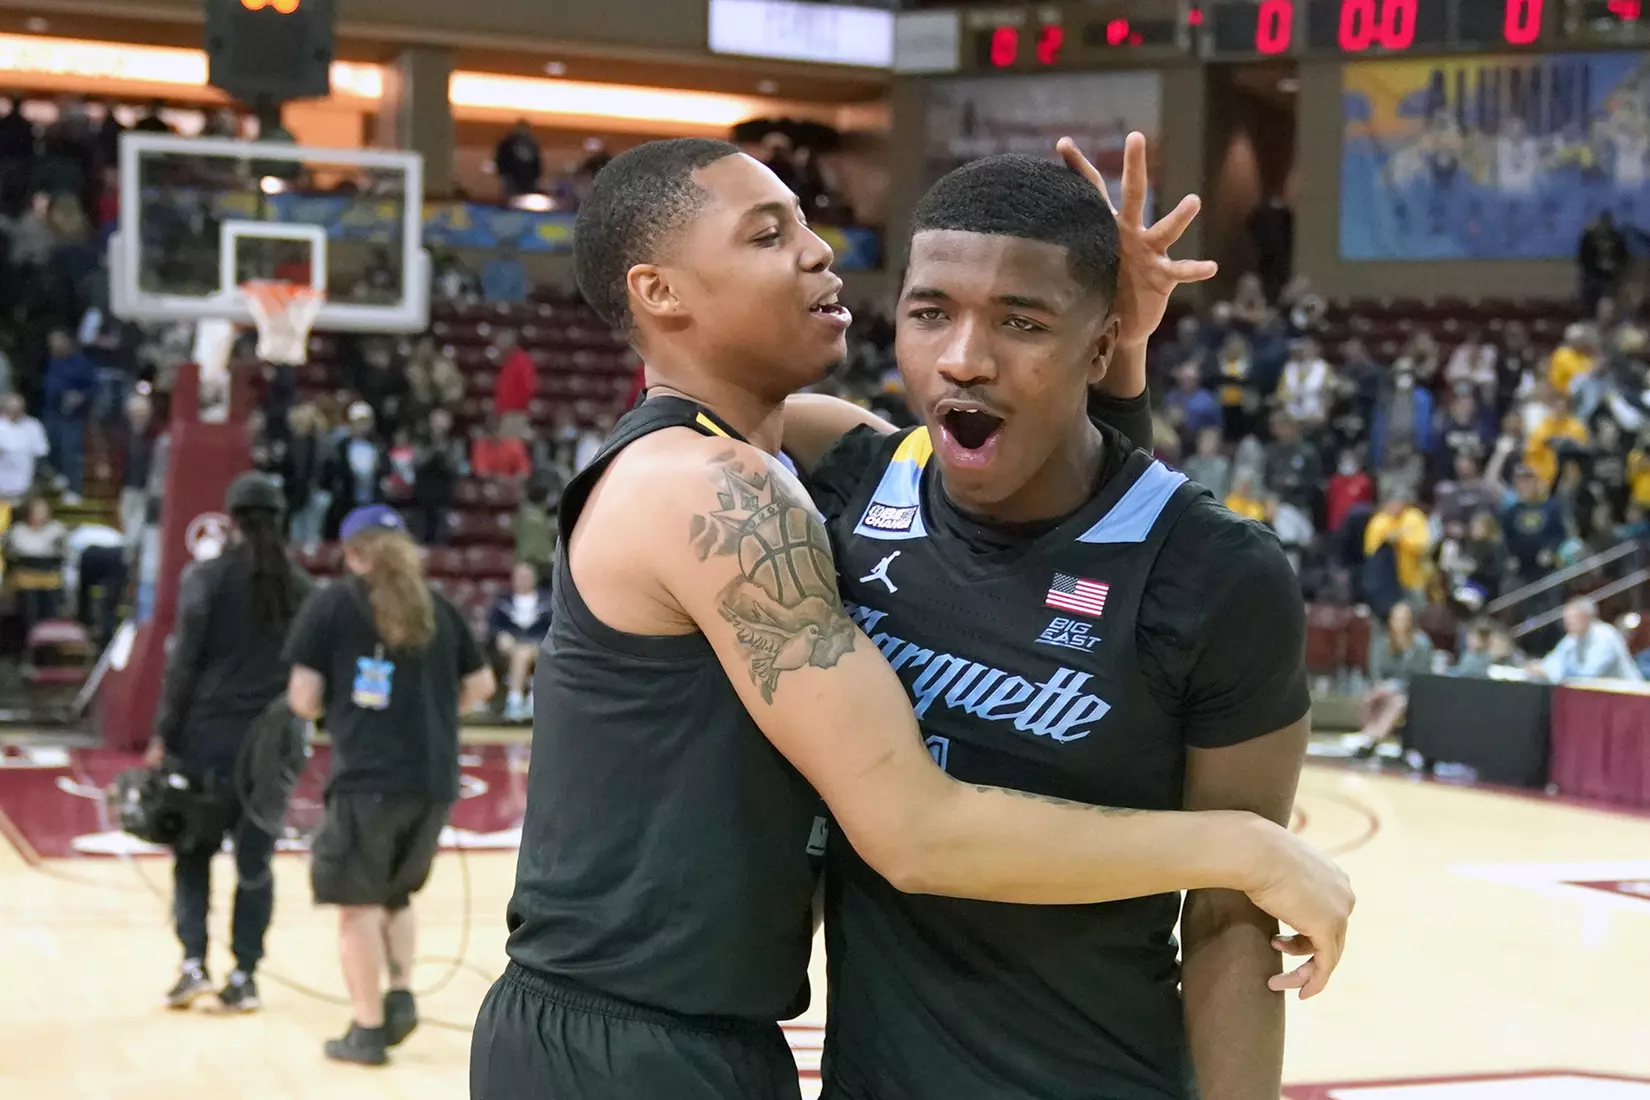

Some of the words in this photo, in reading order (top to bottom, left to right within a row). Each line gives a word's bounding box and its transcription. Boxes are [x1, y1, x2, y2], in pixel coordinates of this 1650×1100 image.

[1256, 0, 1293, 54] 0
[1503, 0, 1544, 44] 0
[1040, 628, 1101, 648] EAST
[1049, 617, 1092, 634] BIG
